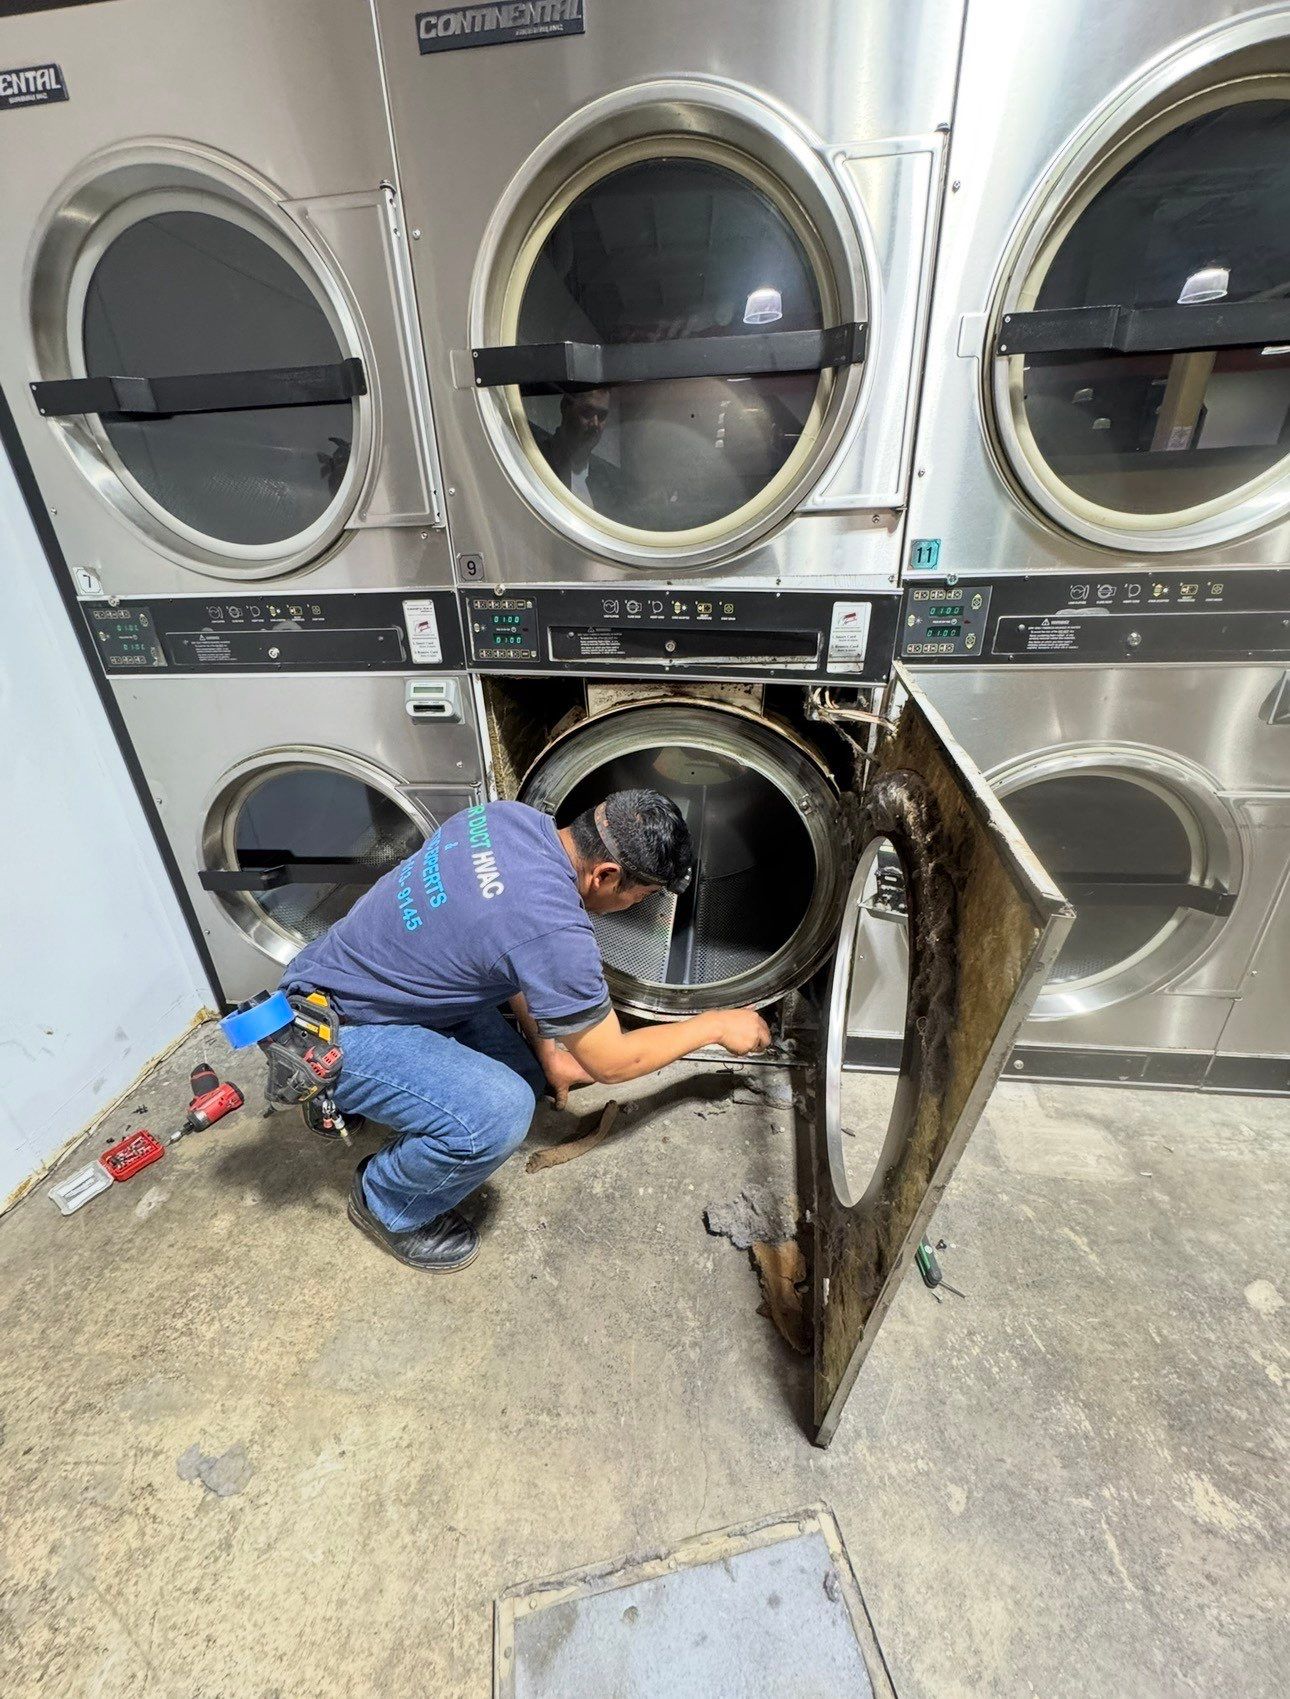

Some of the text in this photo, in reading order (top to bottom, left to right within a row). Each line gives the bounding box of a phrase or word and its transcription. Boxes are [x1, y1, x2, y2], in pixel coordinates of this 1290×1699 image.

[420, 0, 582, 39] CONTINENTAL
[917, 546, 932, 563] 11
[467, 560, 477, 576] 9
[82, 574, 92, 588] 7
[469, 815, 492, 849] DUCT
[471, 850, 505, 899] HVAC
